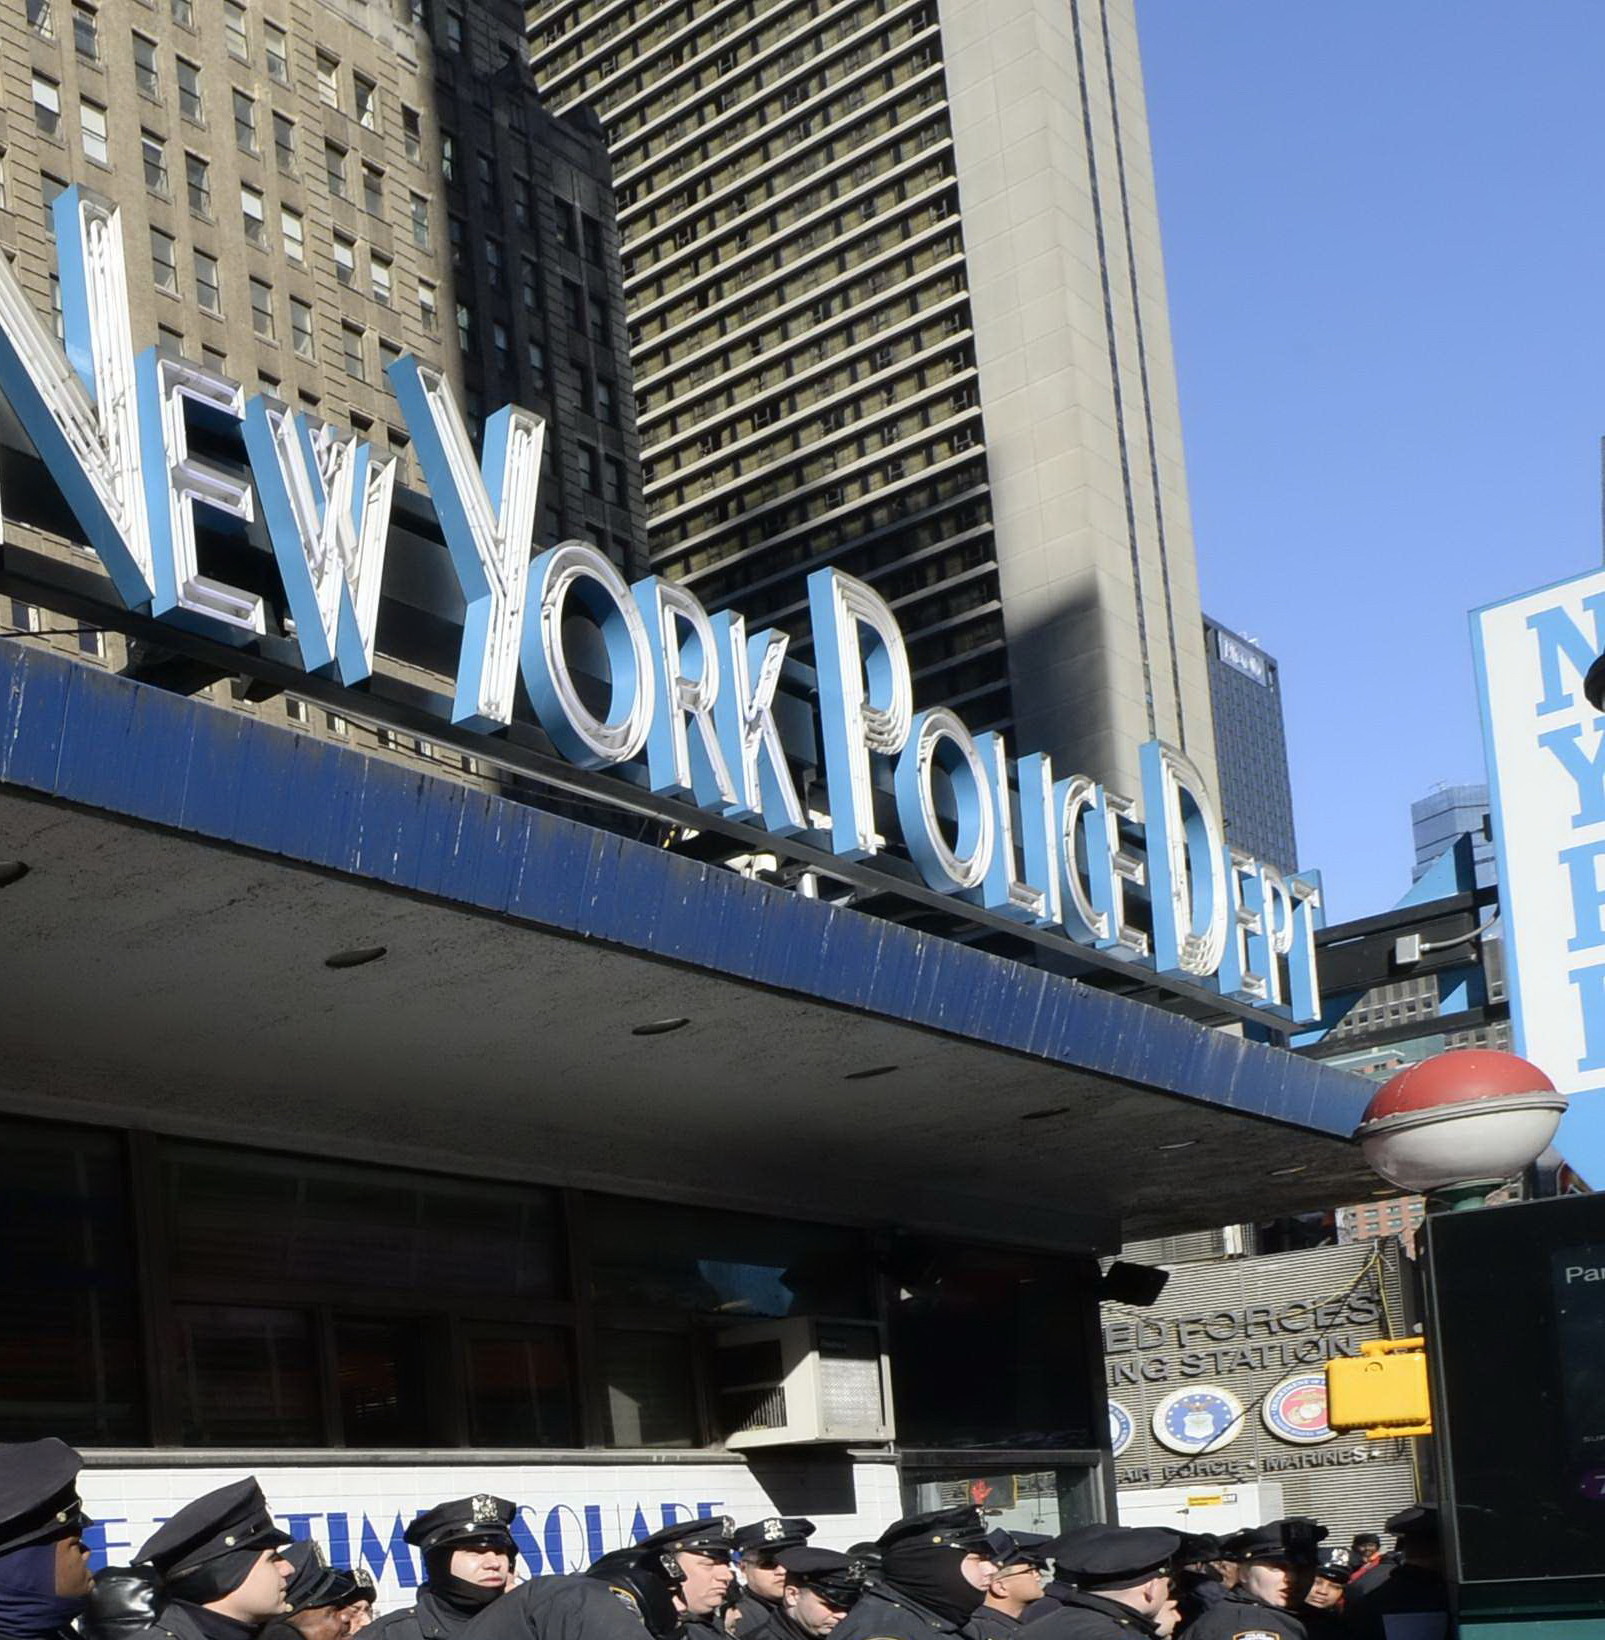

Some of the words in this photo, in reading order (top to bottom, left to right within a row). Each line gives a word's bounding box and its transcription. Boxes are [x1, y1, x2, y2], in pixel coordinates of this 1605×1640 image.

[386, 354, 808, 838] YORK
[808, 567, 1150, 962] POLICE
[1140, 739, 1327, 1024] DEPT
[1178, 1294, 1381, 1349] FORCES
[1180, 1333, 1362, 1377] STATION
